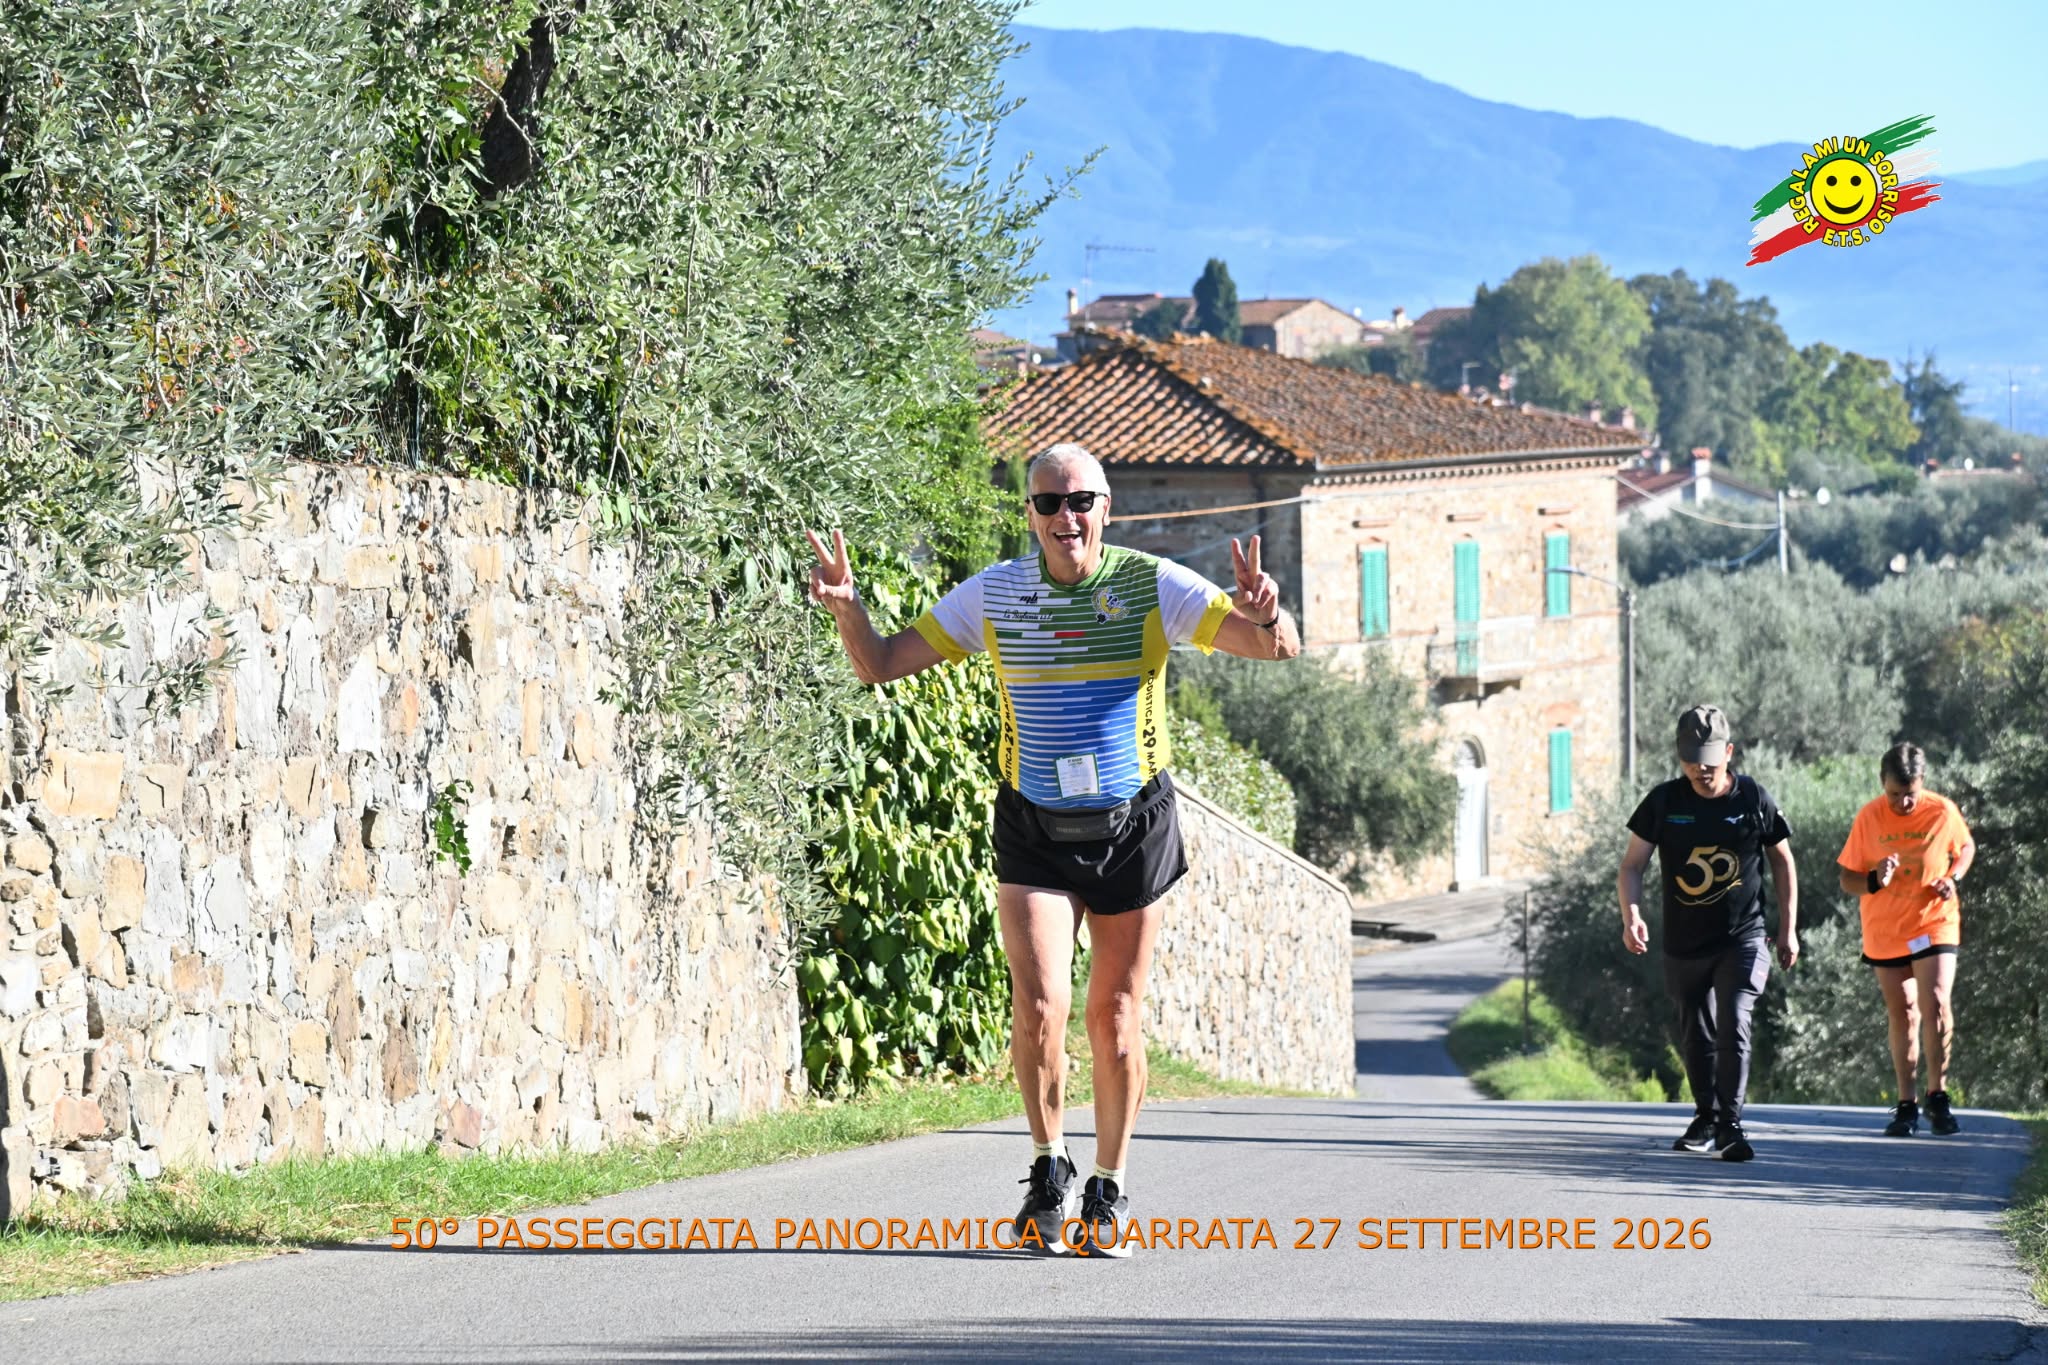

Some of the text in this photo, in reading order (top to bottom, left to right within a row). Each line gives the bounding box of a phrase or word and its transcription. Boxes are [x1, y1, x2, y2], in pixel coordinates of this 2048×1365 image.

[1145, 668, 1156, 726] PODISTICA
[1004, 721, 1014, 746] 29
[1142, 726, 1157, 748] 29
[1675, 845, 1737, 896] 50
